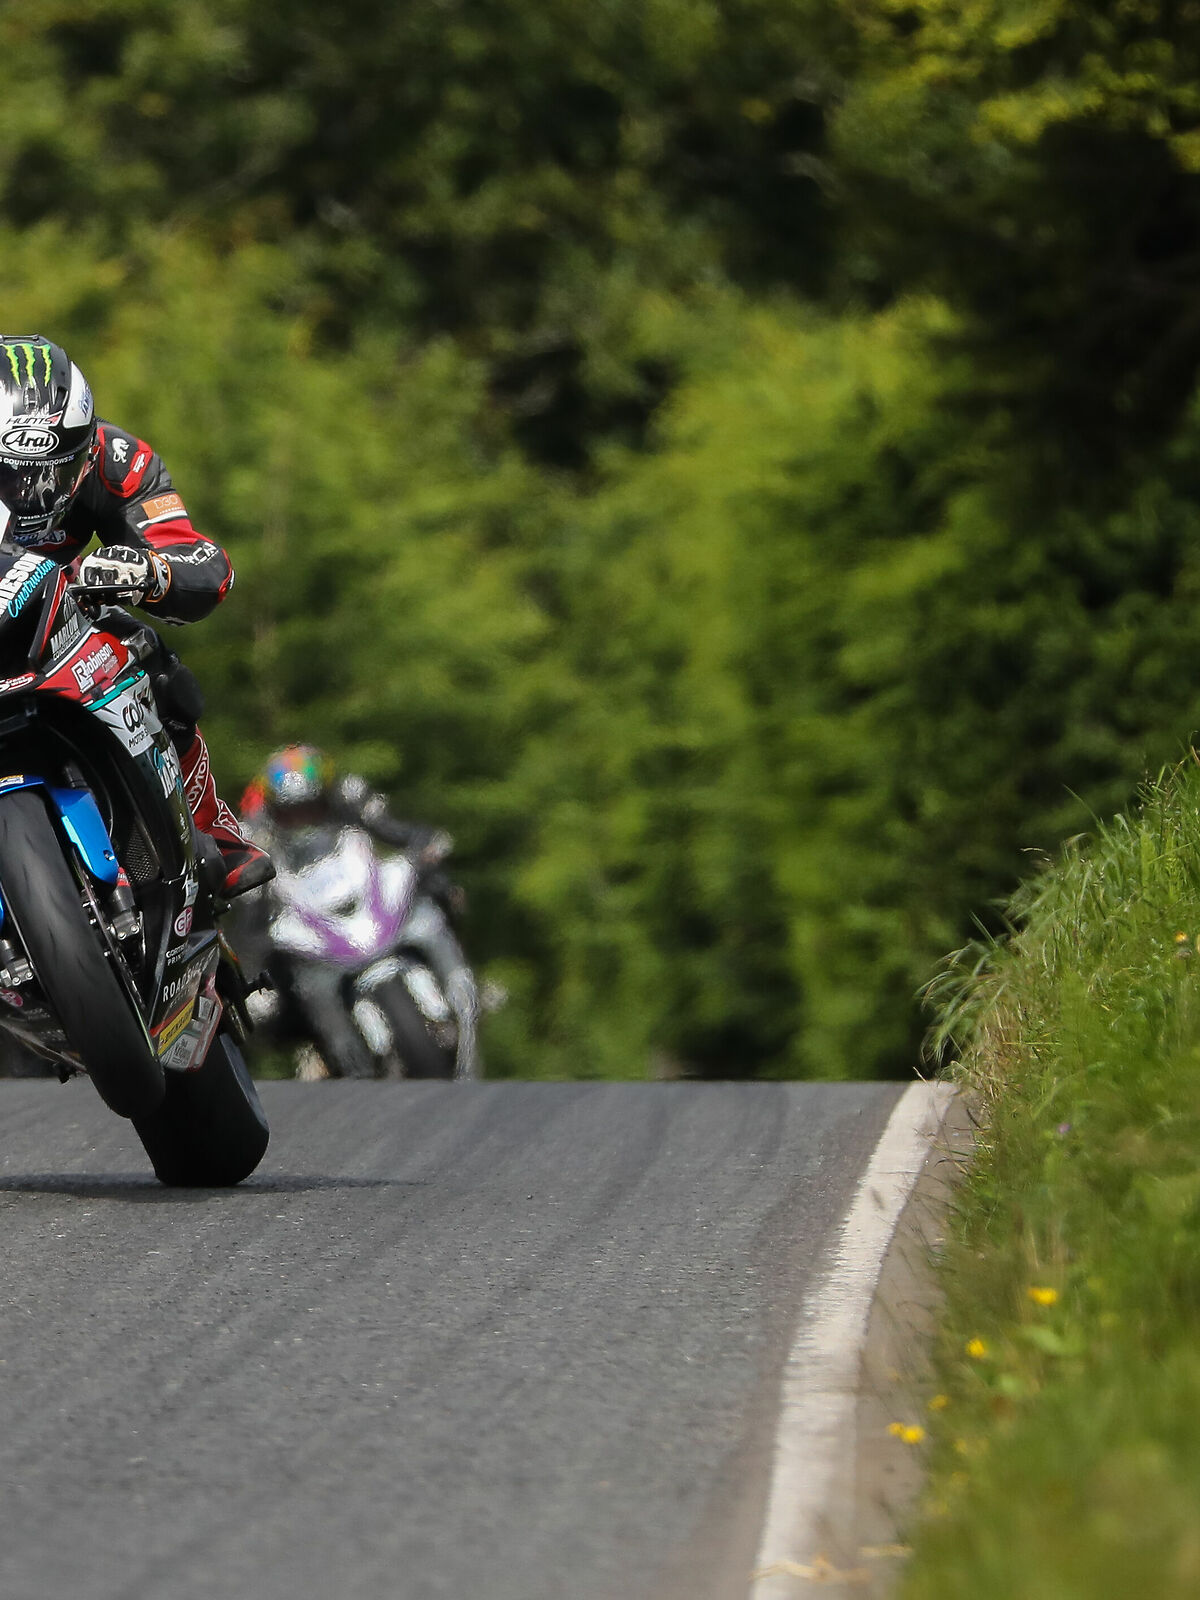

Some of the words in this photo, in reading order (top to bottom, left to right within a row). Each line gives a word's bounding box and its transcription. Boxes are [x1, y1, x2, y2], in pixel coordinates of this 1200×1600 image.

[3, 455, 35, 466] COUNTY
[35, 456, 69, 467] WINDOWS
[5, 431, 52, 448] Arai
[7, 559, 57, 618] Construction
[50, 612, 79, 655] MARLOW
[71, 643, 114, 693] Robinson
